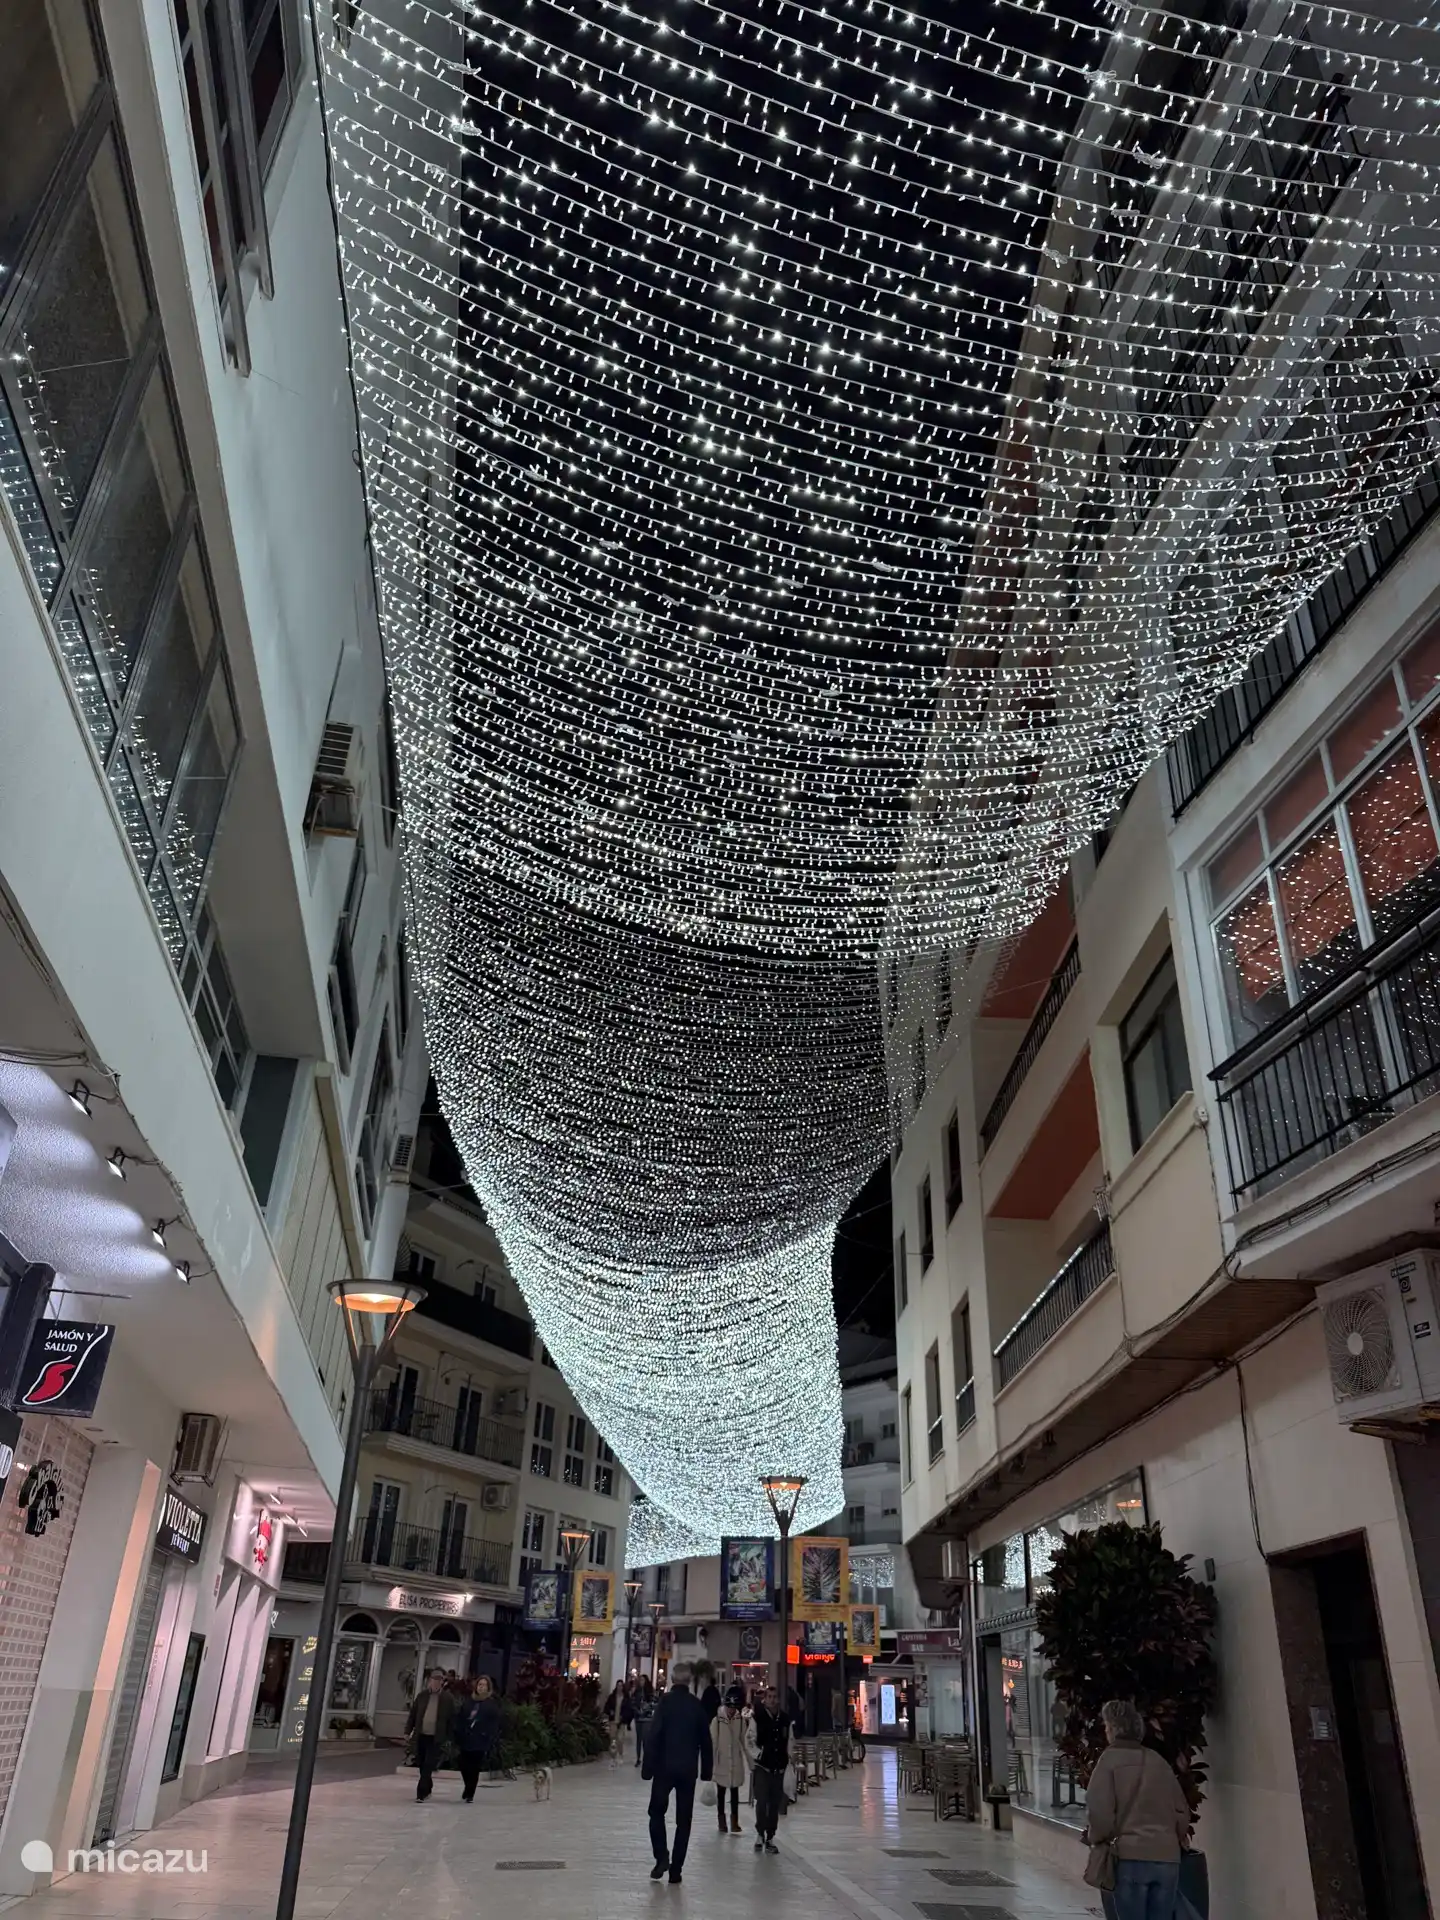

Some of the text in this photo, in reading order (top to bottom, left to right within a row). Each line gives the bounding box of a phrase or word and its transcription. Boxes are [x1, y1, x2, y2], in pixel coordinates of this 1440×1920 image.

[46, 1329, 94, 1341] JAMÓN Y
[44, 1342, 78, 1353] SALUD
[166, 1494, 203, 1545] VIOLETTA
